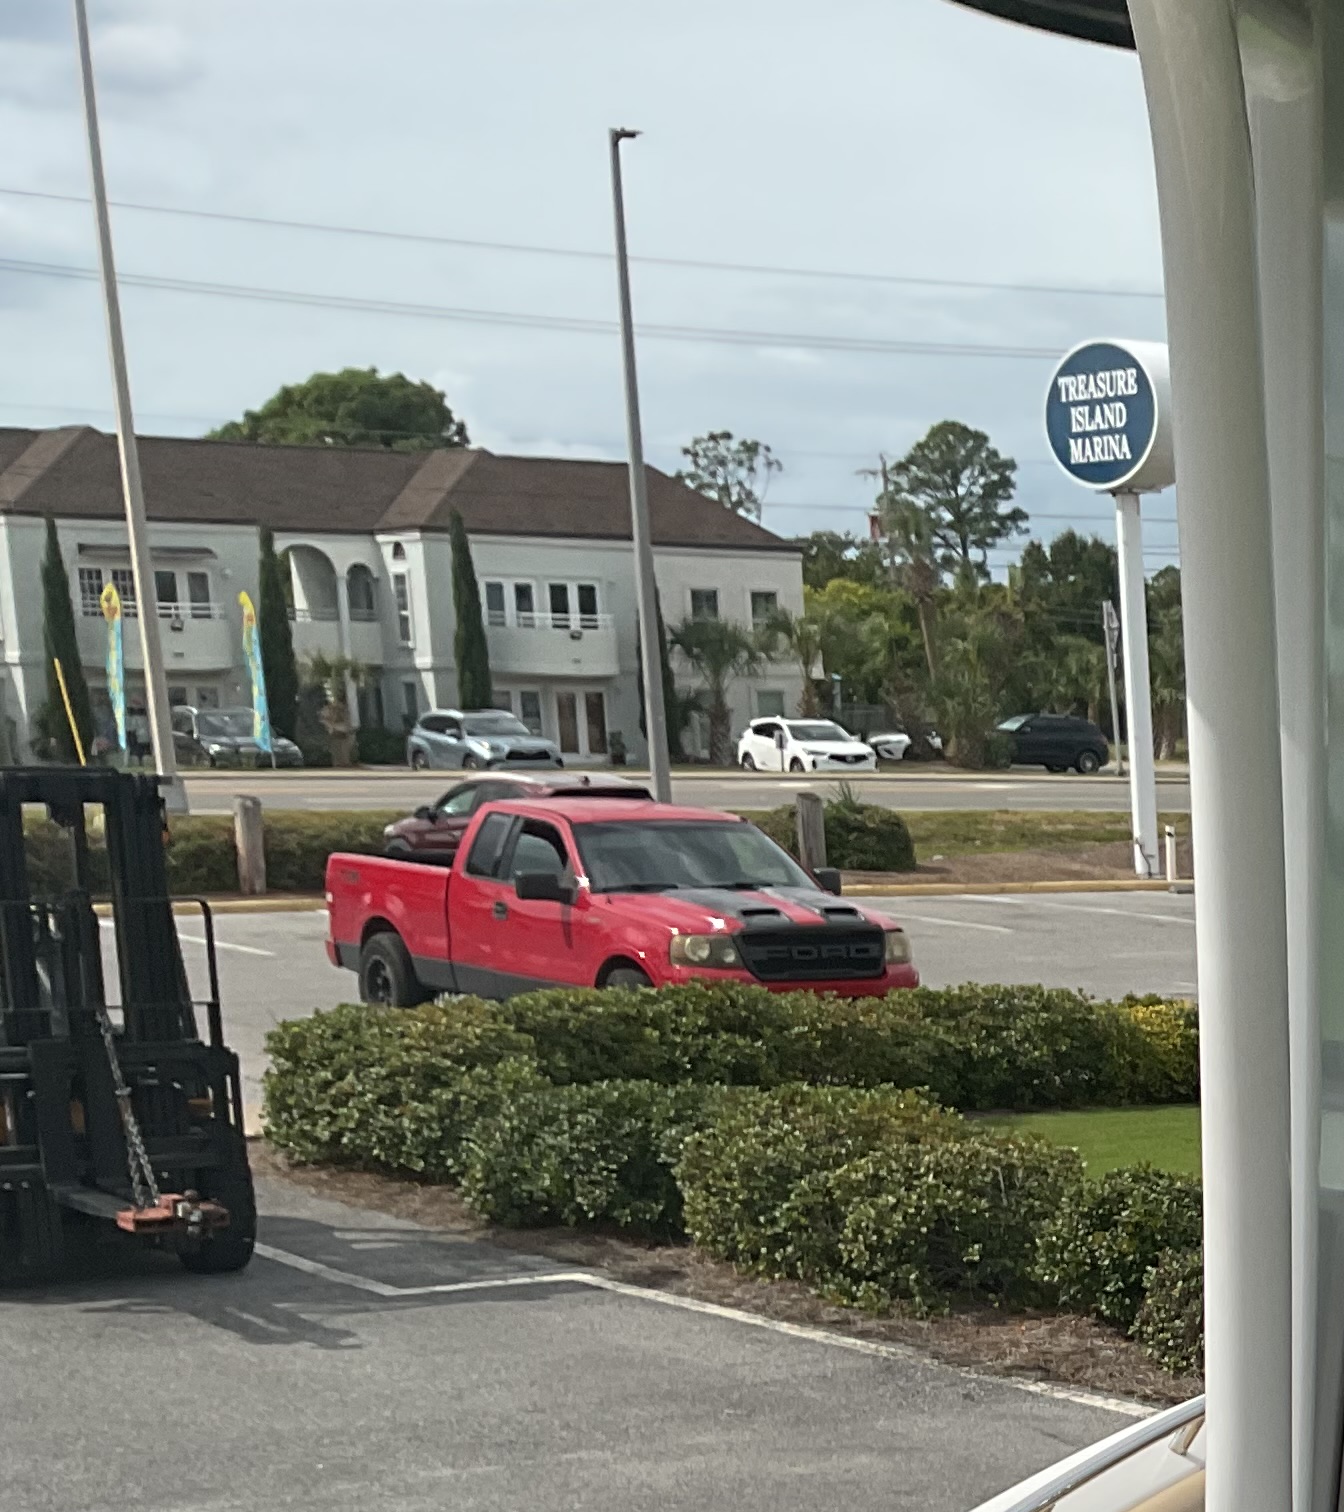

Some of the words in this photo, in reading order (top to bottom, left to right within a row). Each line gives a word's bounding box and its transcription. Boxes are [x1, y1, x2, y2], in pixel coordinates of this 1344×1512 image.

[1058, 368, 1138, 402] TREASURE
[1070, 402, 1127, 433] ISLAND
[1069, 434, 1132, 464] MARINA
